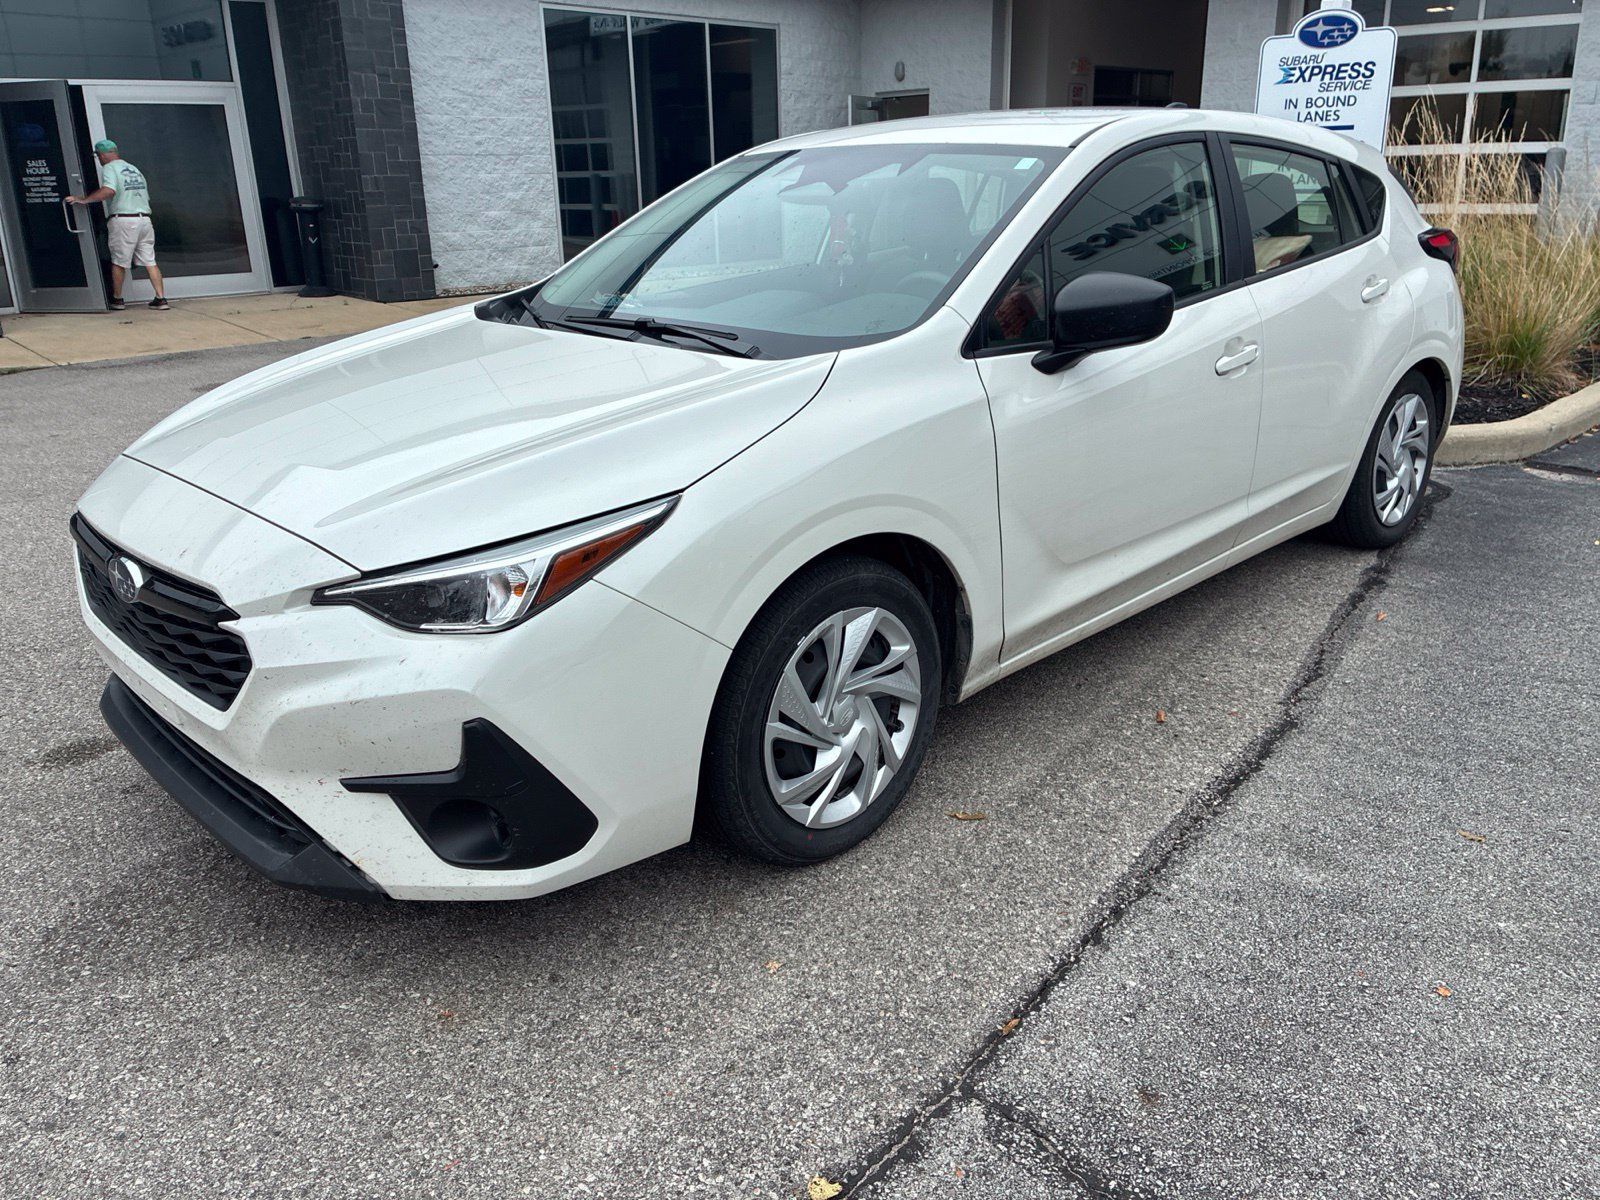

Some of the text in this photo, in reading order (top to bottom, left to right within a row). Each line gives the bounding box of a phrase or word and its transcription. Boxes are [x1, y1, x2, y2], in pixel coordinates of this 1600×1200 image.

[1278, 52, 1327, 67] SUBARU
[1274, 61, 1376, 85] EXPRESS
[1318, 80, 1372, 93] SERVICE
[1284, 95, 1357, 110] IN BOUND
[1297, 110, 1340, 123] LANES
